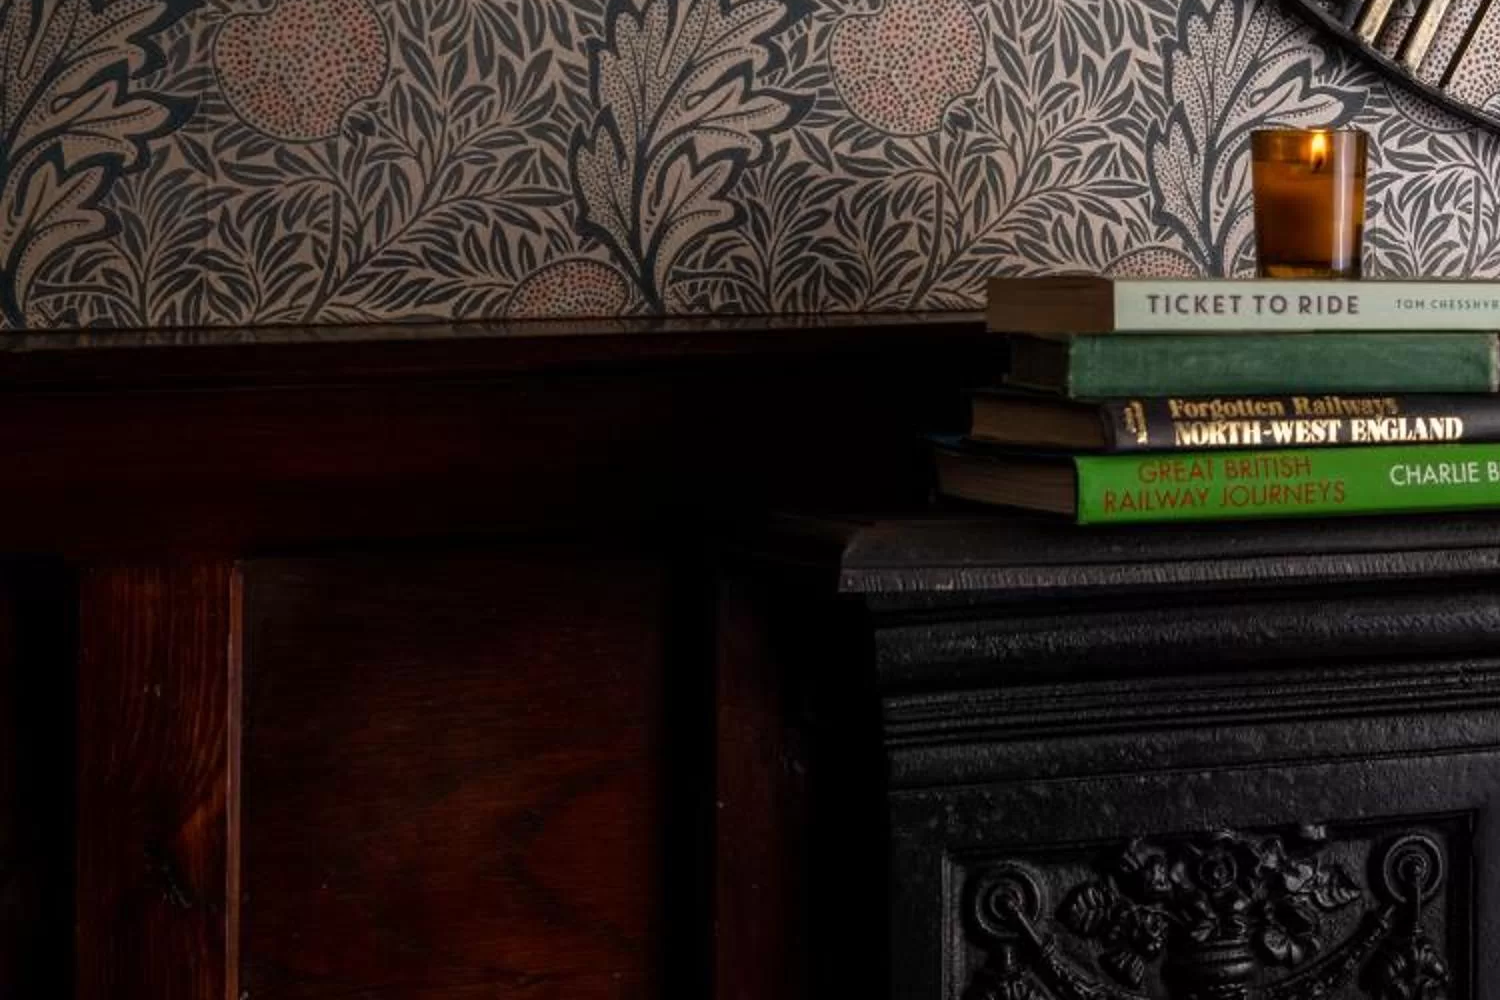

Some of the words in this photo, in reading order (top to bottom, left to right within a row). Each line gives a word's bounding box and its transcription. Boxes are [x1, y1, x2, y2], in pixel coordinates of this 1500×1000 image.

[1146, 294, 1242, 315] TICKET
[1252, 294, 1288, 315] TO
[1298, 294, 1360, 315] RIDE
[1395, 298, 1425, 310] TOM
[1167, 397, 1285, 422] Forgotten
[1293, 395, 1397, 420] Railways
[1173, 418, 1342, 446] NORTH-WEST
[1350, 416, 1464, 441] ENGLAND
[1138, 456, 1215, 484] GREAT
[1224, 455, 1312, 480] BRITISH
[1389, 462, 1480, 486] CHARLIE
[1103, 487, 1210, 514] RAILWAY
[1219, 480, 1346, 509] JOURNEYS
